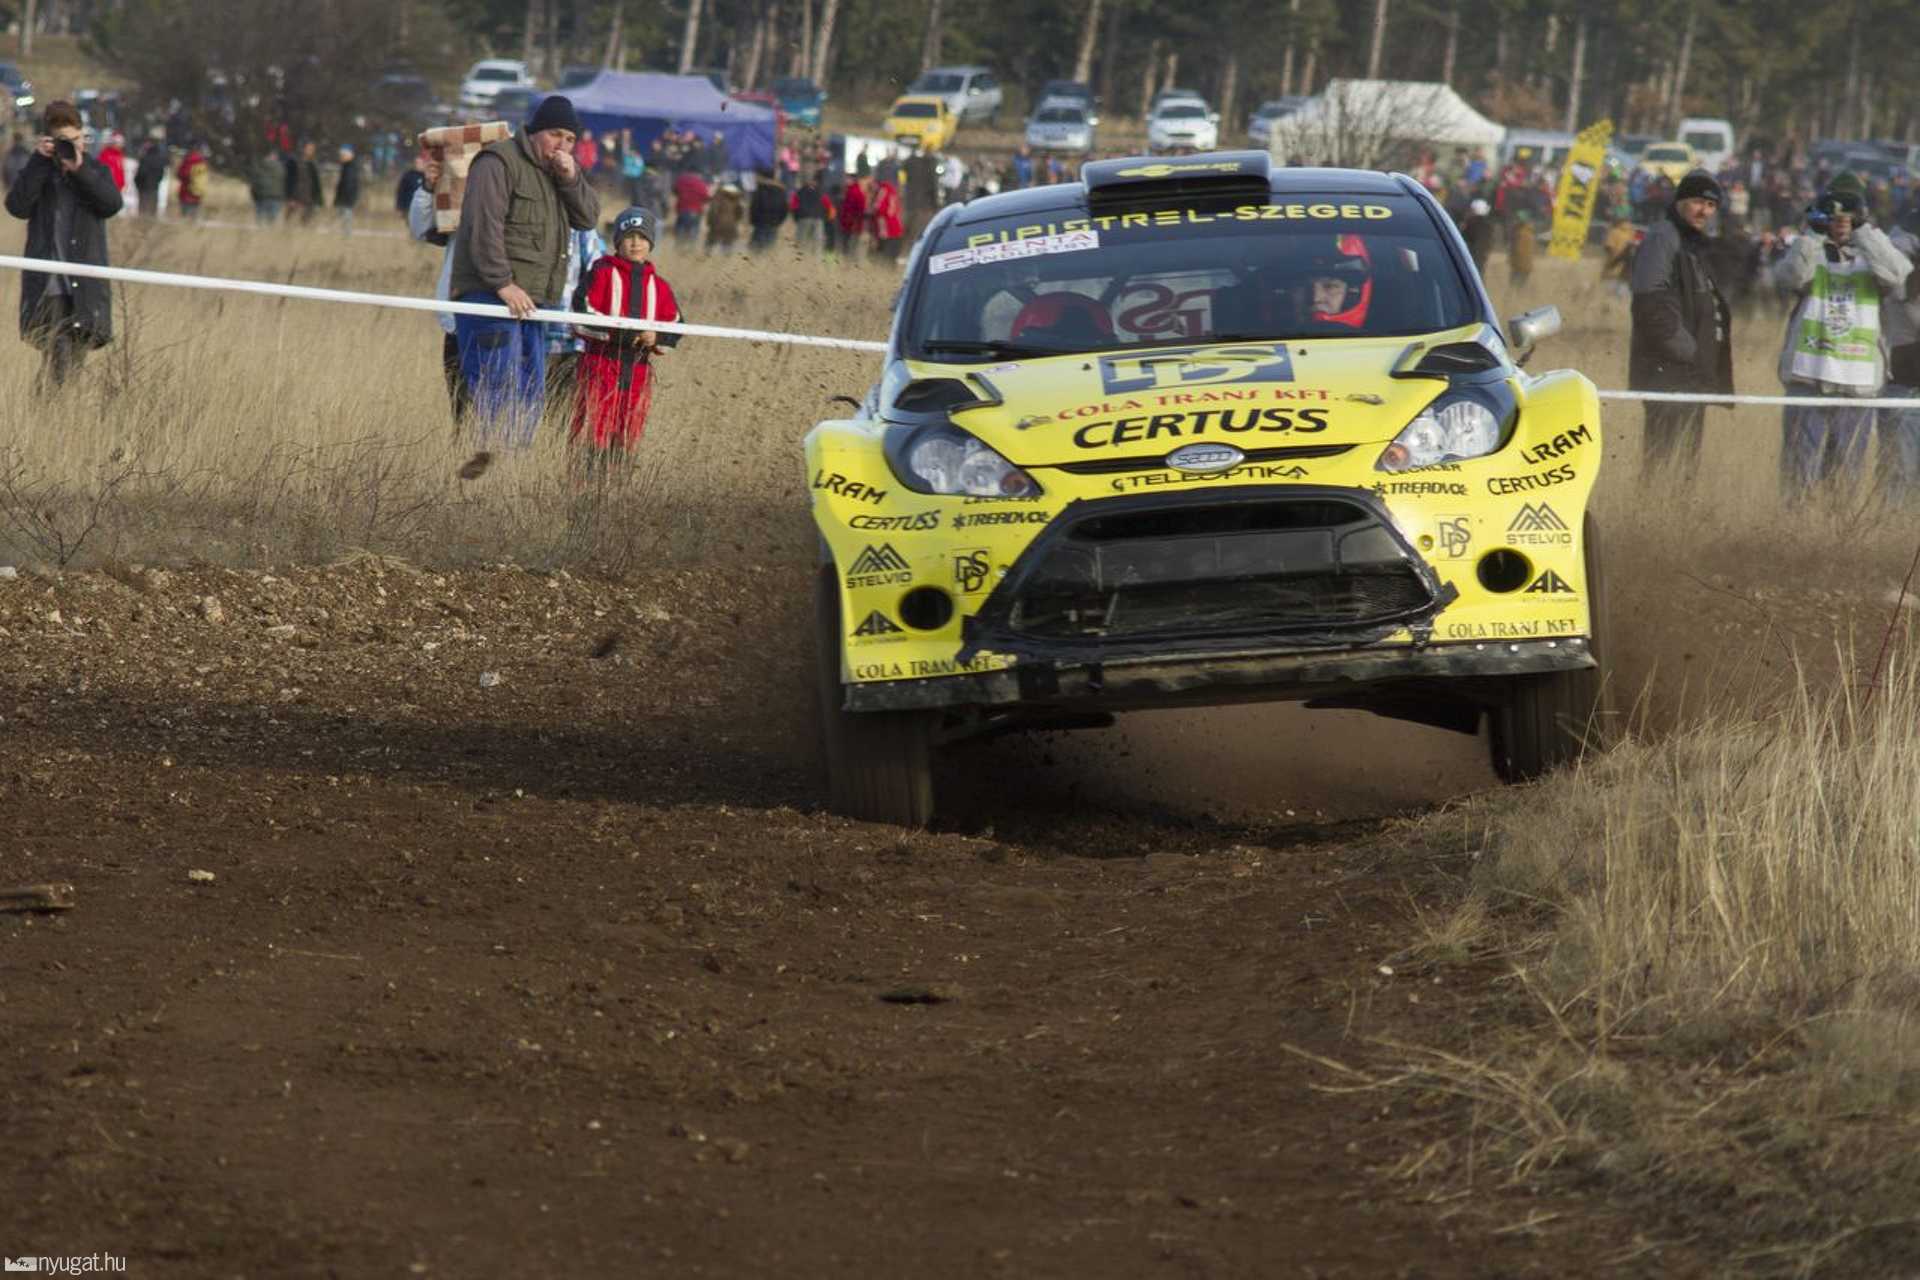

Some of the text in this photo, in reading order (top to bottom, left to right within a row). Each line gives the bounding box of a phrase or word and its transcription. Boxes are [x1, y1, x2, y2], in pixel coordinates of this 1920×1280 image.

[1058, 400, 1143, 420] COLA
[1073, 408, 1329, 449] CERTUSS
[1487, 463, 1576, 496] CERTUSS
[850, 509, 941, 531] CERTUSS
[1506, 533, 1573, 545] STELVIO
[846, 571, 913, 588] STELVIO
[1448, 622, 1487, 638] COLA
[855, 662, 903, 679] COLA
